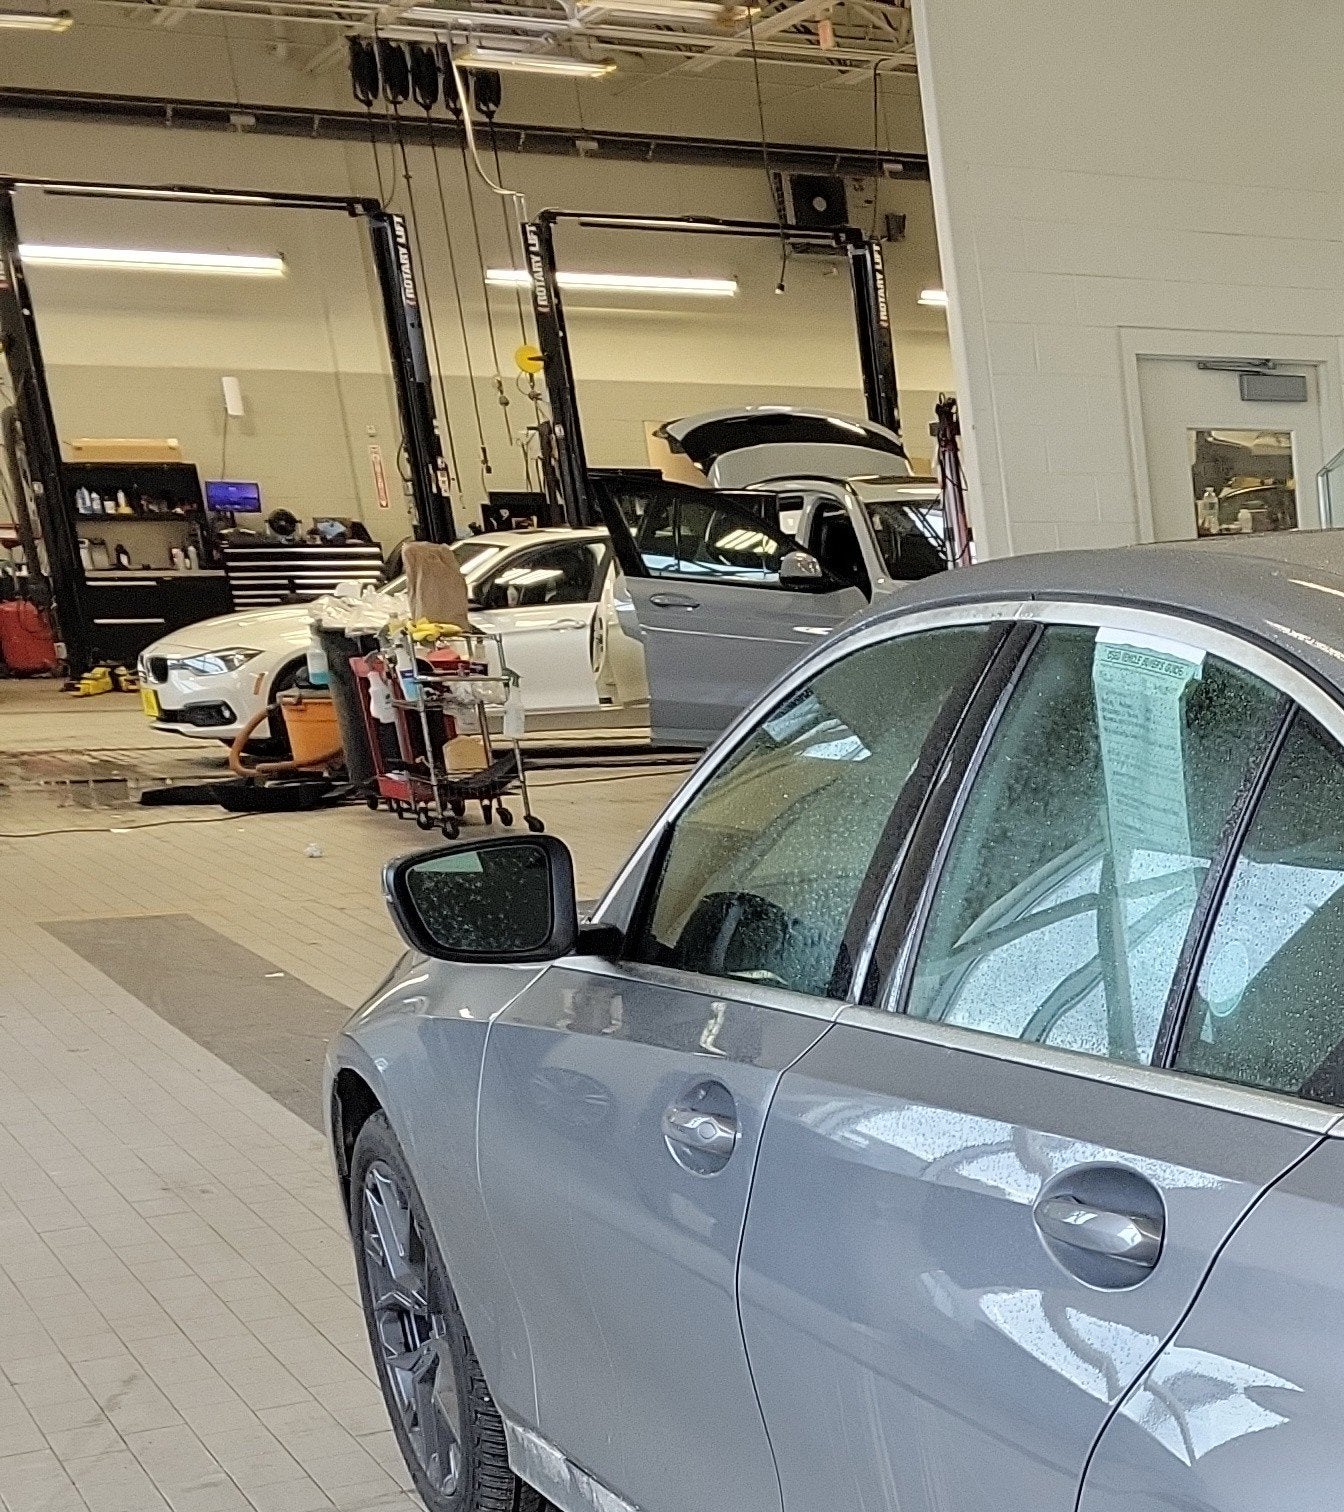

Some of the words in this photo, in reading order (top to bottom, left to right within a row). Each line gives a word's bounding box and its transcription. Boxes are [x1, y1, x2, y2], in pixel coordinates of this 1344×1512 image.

[392, 214, 407, 244] LIFT
[525, 223, 540, 252] LIFT
[397, 245, 416, 299] ROTARY
[530, 253, 549, 306] ROTARY
[875, 271, 888, 321] ROTARY
